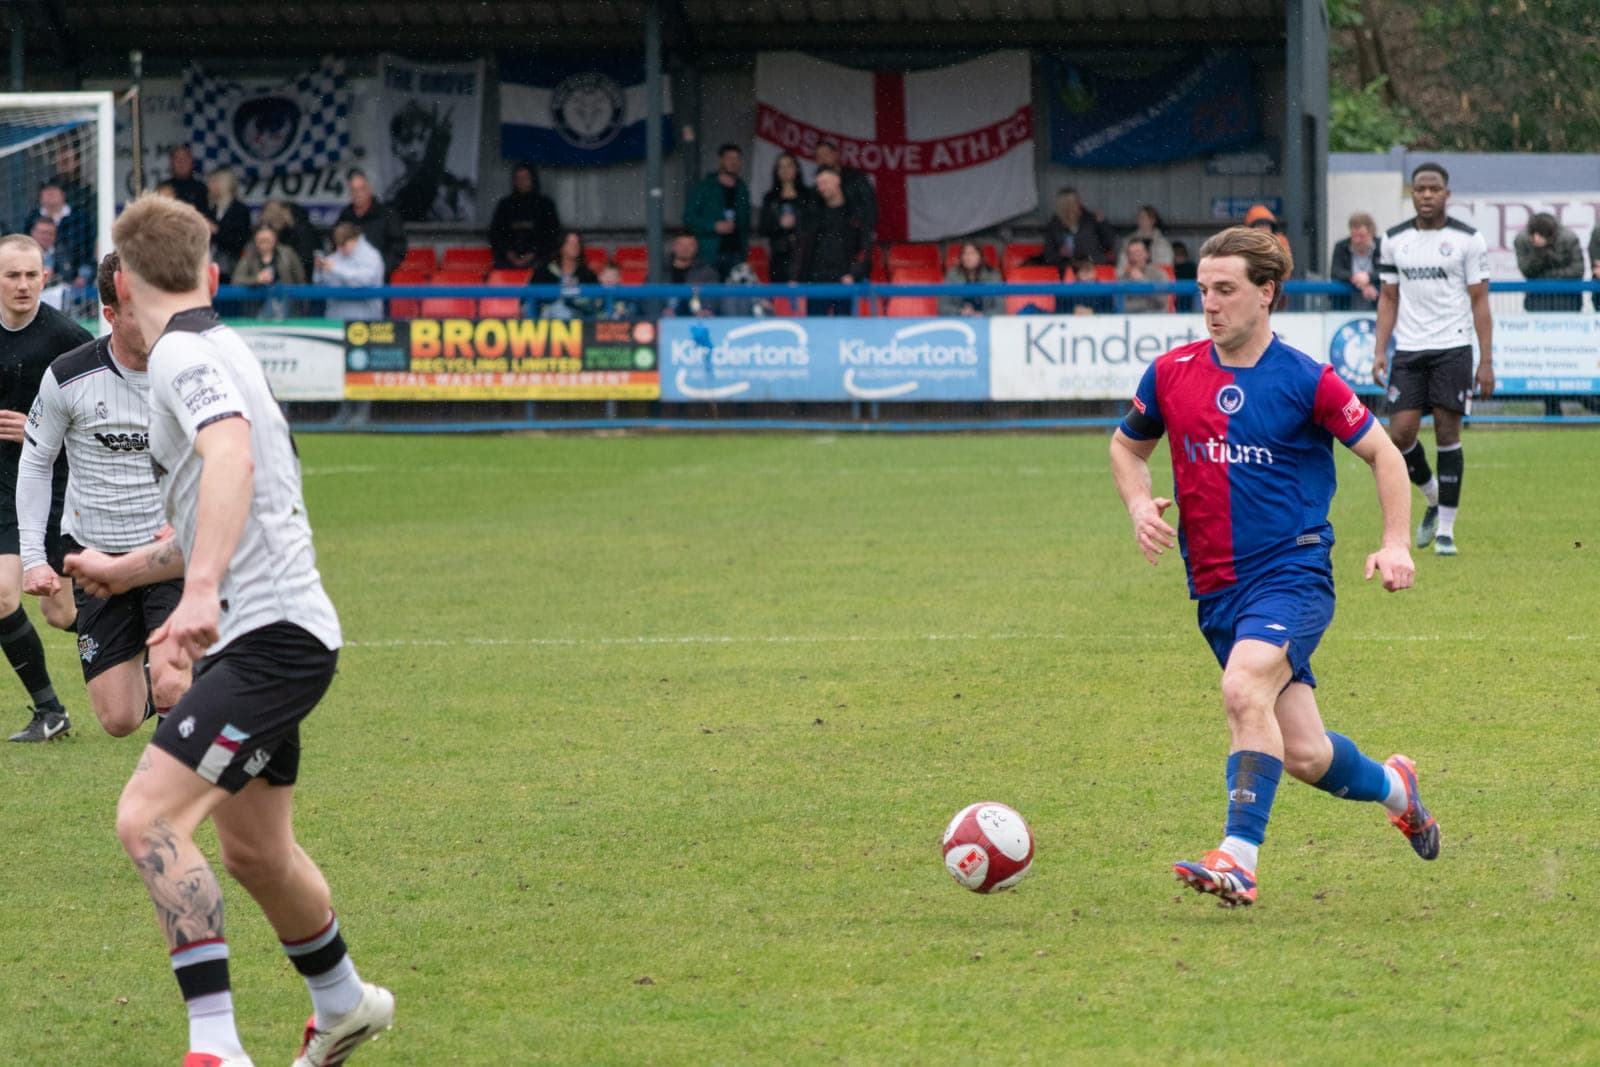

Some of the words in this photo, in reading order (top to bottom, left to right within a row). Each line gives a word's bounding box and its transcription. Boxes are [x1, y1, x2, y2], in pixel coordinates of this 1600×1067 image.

[410, 319, 582, 358] BROWN
[839, 338, 978, 366] Kindertons
[373, 372, 427, 386] TOTAL
[435, 373, 493, 386] WASTE
[502, 372, 630, 386] MANAGEMENT
[410, 358, 508, 373] RECYCLING
[511, 358, 582, 373] LIMITED
[1185, 433, 1273, 465] Intium
